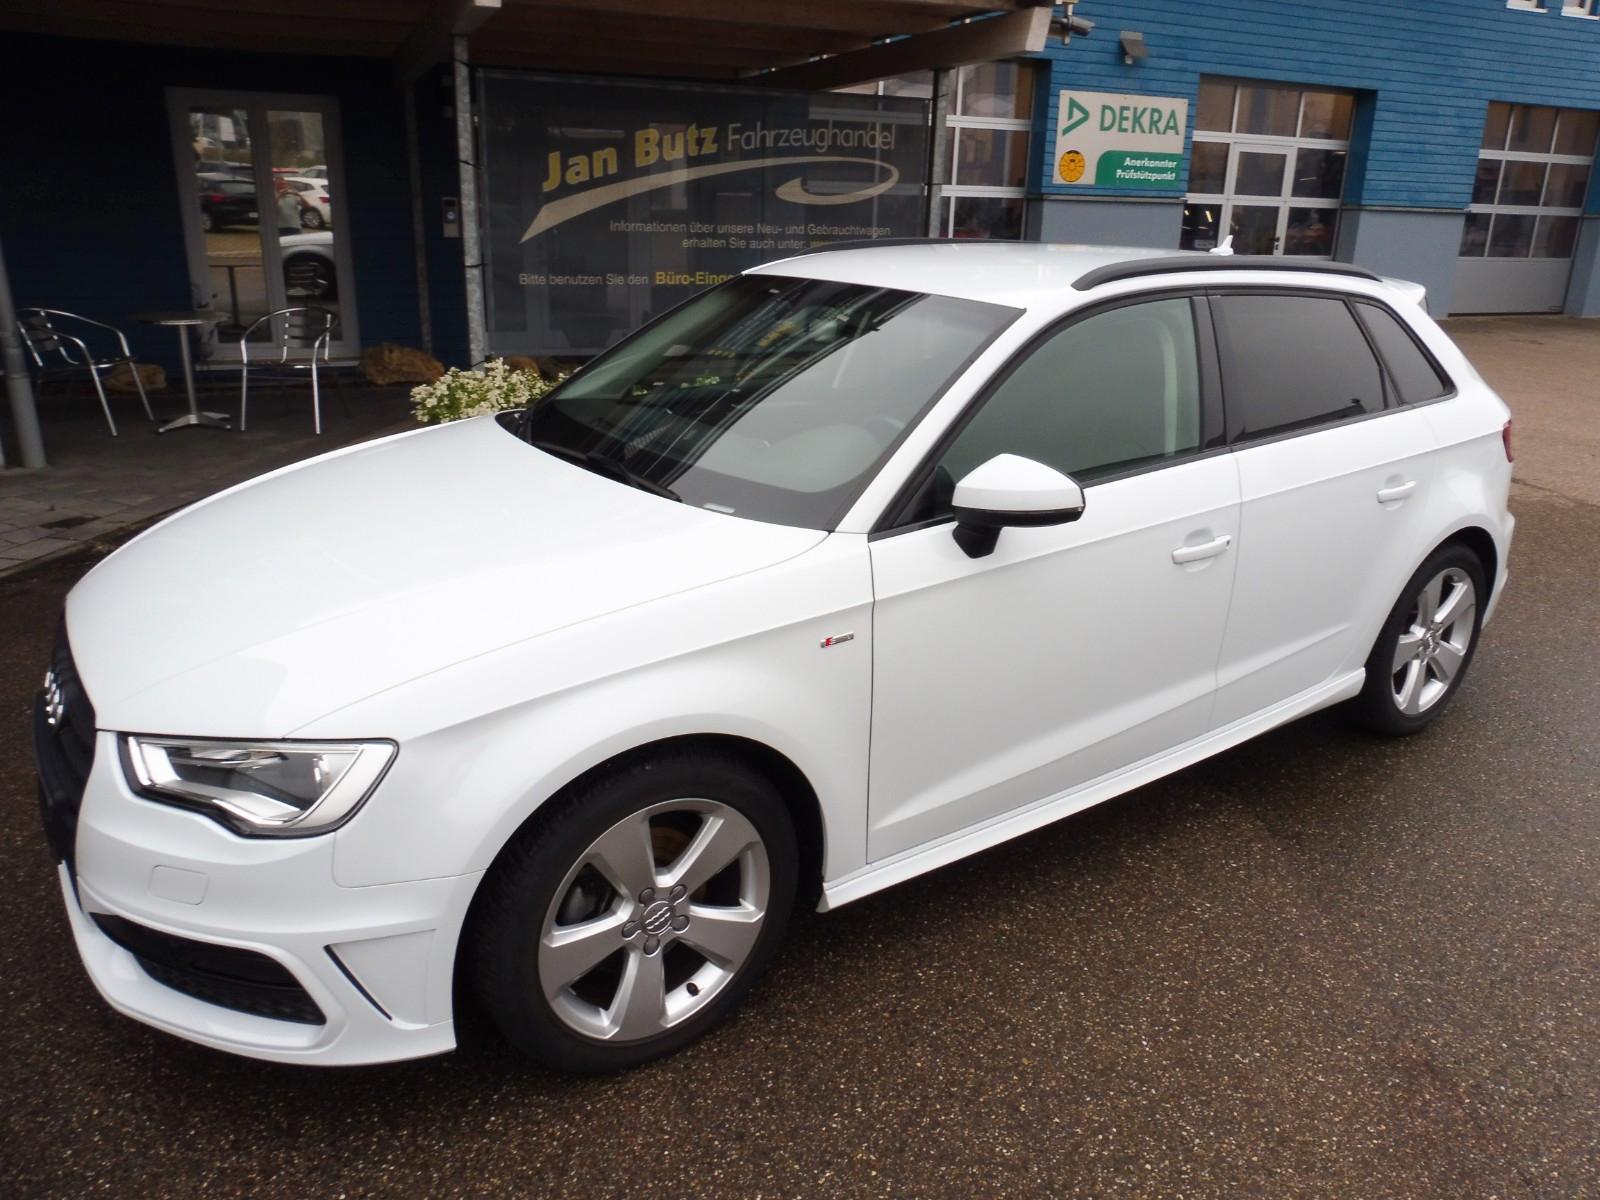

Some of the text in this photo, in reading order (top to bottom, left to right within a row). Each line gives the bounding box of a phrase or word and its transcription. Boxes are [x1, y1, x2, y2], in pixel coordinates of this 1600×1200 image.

[1099, 104, 1180, 136] DEKRA
[541, 120, 896, 192] Jan Butz Fahrzeughandel
[1123, 156, 1177, 168] Anerkannter
[1115, 168, 1176, 182] Prüfstützpunkt
[609, 220, 891, 238] Informationen über unsere Neu- und Gebrauchtwagen
[681, 237, 726, 249] erhalten
[728, 237, 747, 249] Sie
[749, 239, 775, 249] auch
[519, 273, 547, 285] Bitte
[549, 274, 603, 285] benutzen
[605, 273, 625, 285] Sie
[627, 274, 649, 285] den
